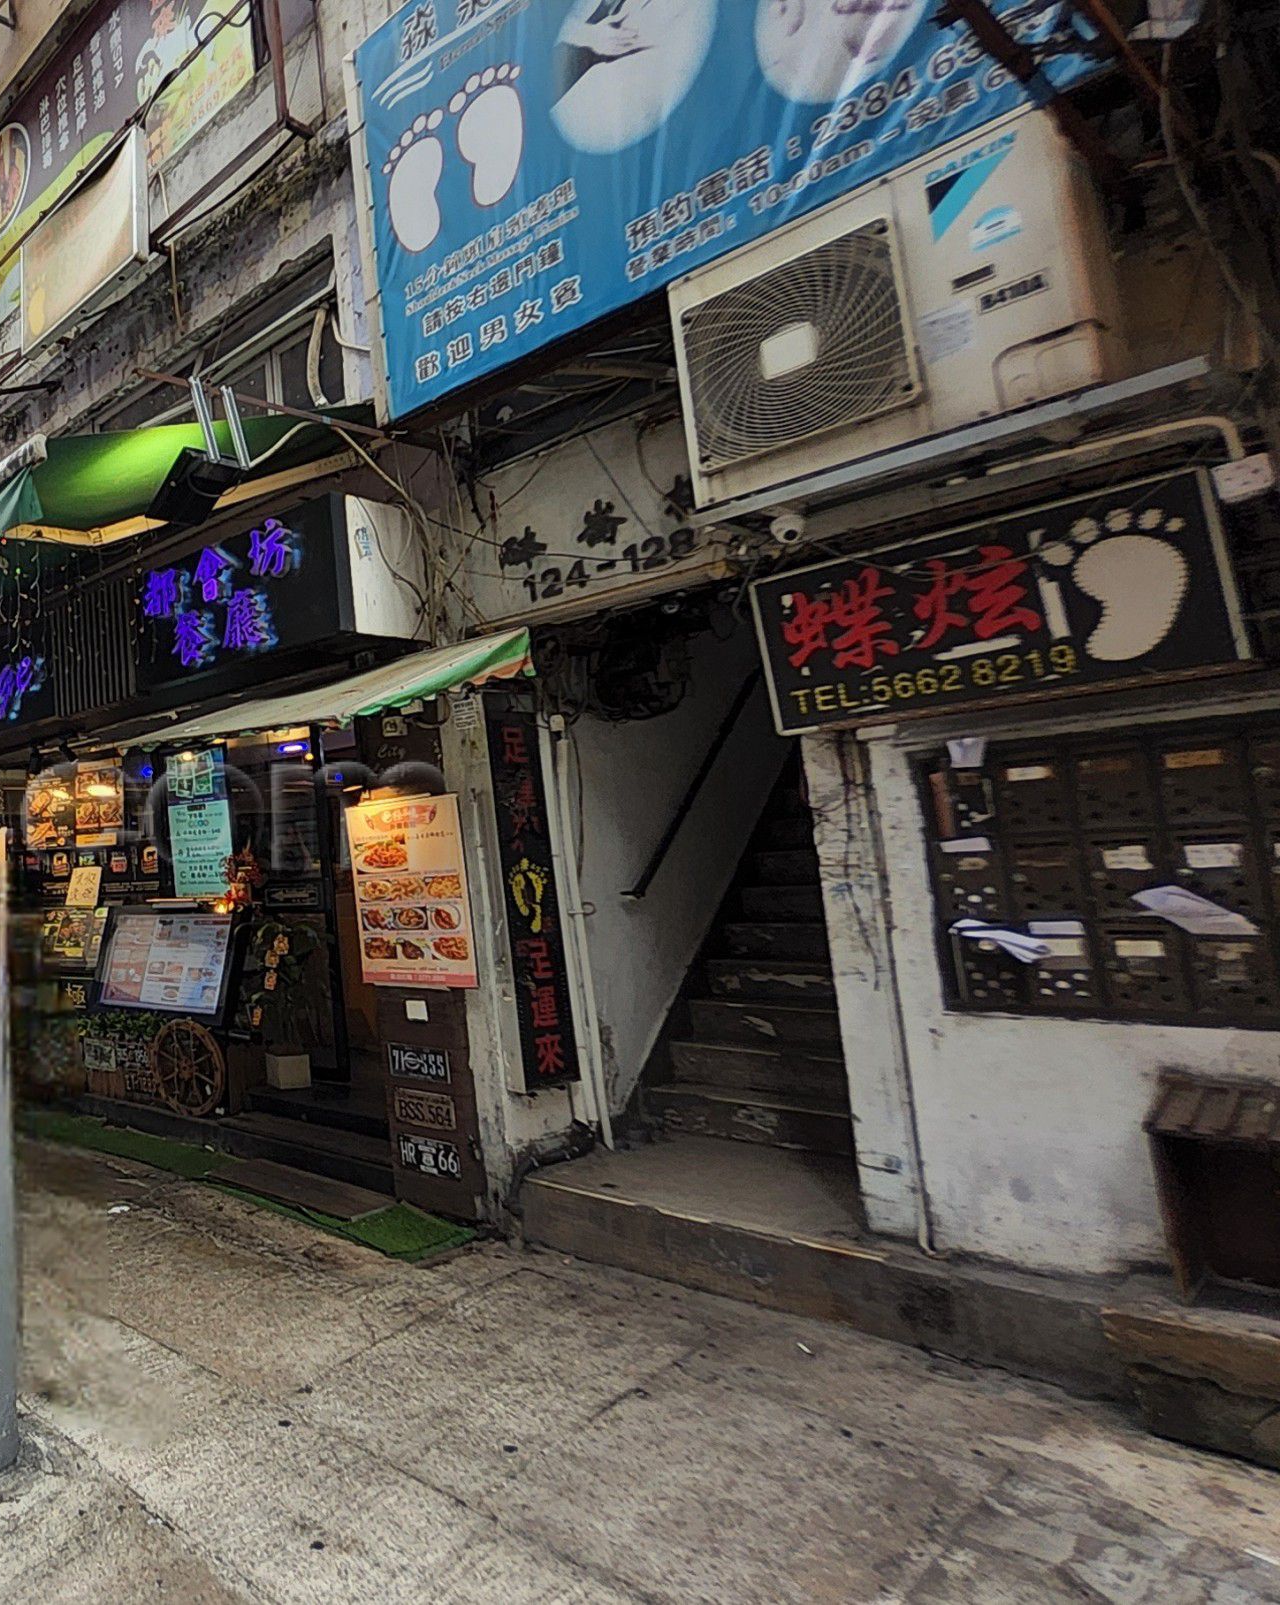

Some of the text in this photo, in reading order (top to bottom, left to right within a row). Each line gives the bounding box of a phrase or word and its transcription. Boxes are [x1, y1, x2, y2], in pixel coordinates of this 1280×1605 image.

[810, 71, 918, 151] 2384
[924, 130, 1019, 186] DAIKIN
[415, 273, 584, 384] 歡迎男女賓
[523, 526, 697, 603] 124-128
[970, 643, 1078, 688] 8219
